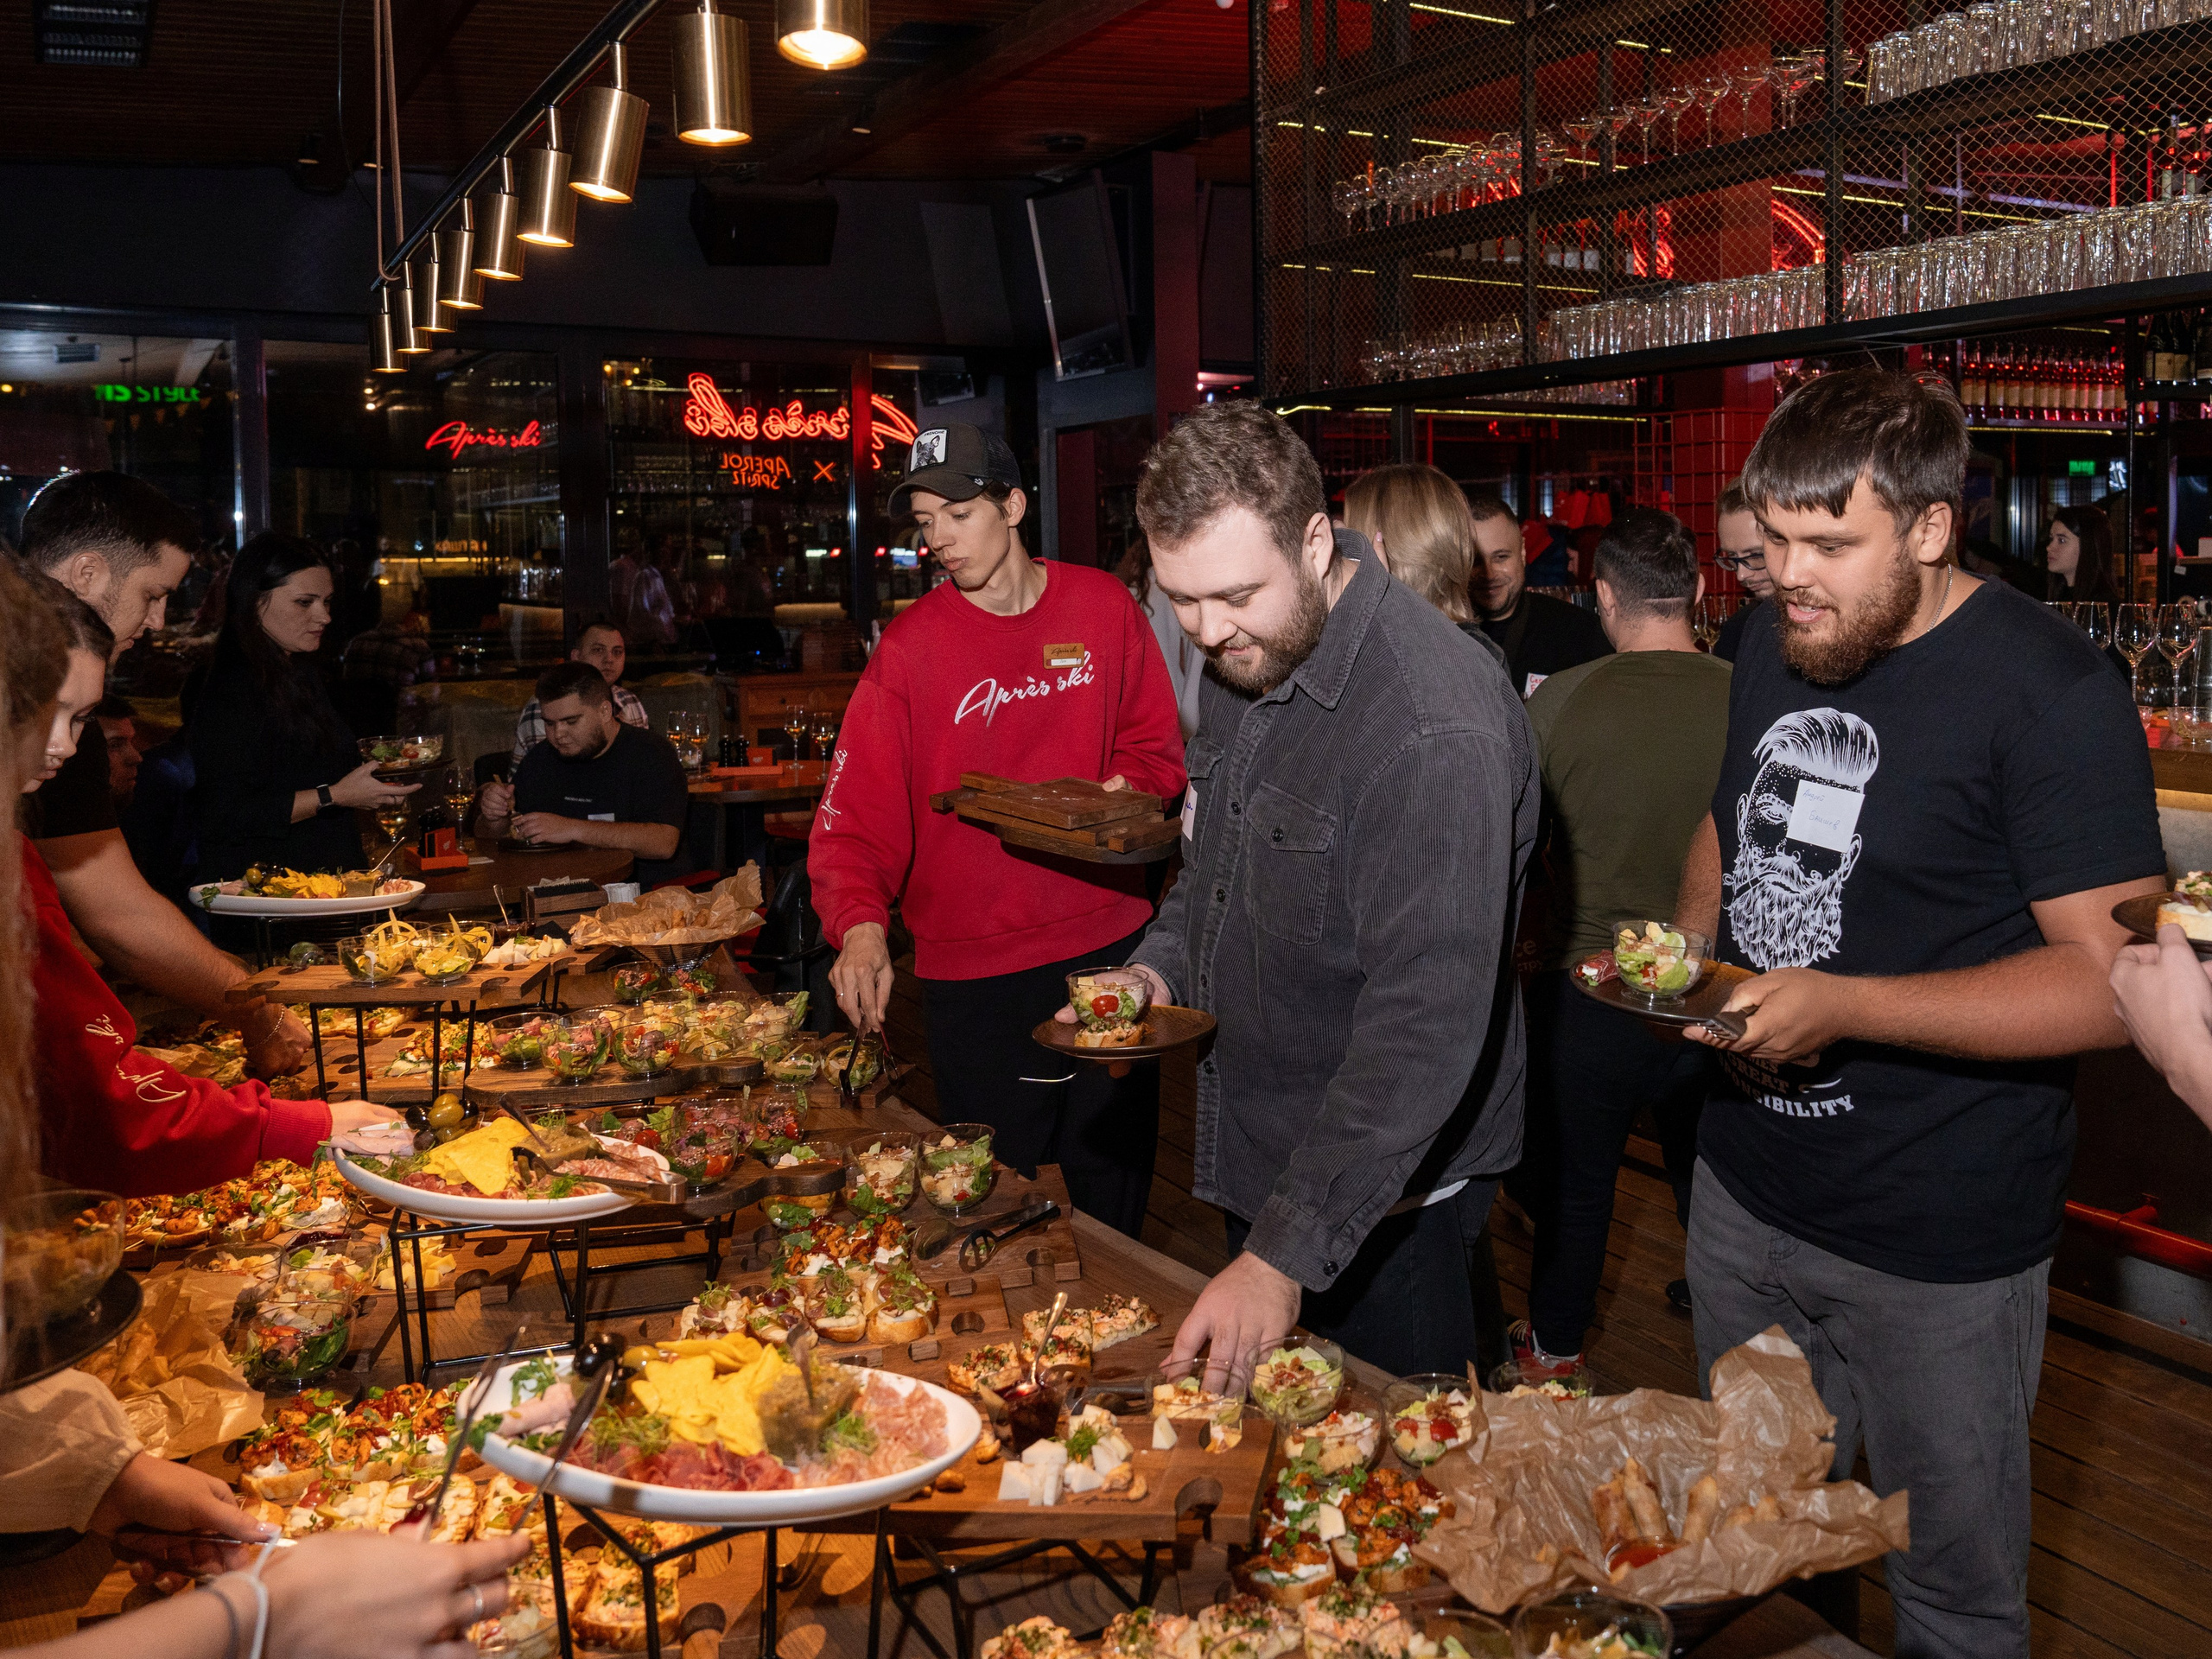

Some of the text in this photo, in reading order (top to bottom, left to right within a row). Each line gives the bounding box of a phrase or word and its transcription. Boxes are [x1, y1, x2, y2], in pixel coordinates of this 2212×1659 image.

[425, 420, 541, 460] Après ski
[954, 651, 1095, 728] Après ski
[1727, 1049, 1789, 1095] GREAT
